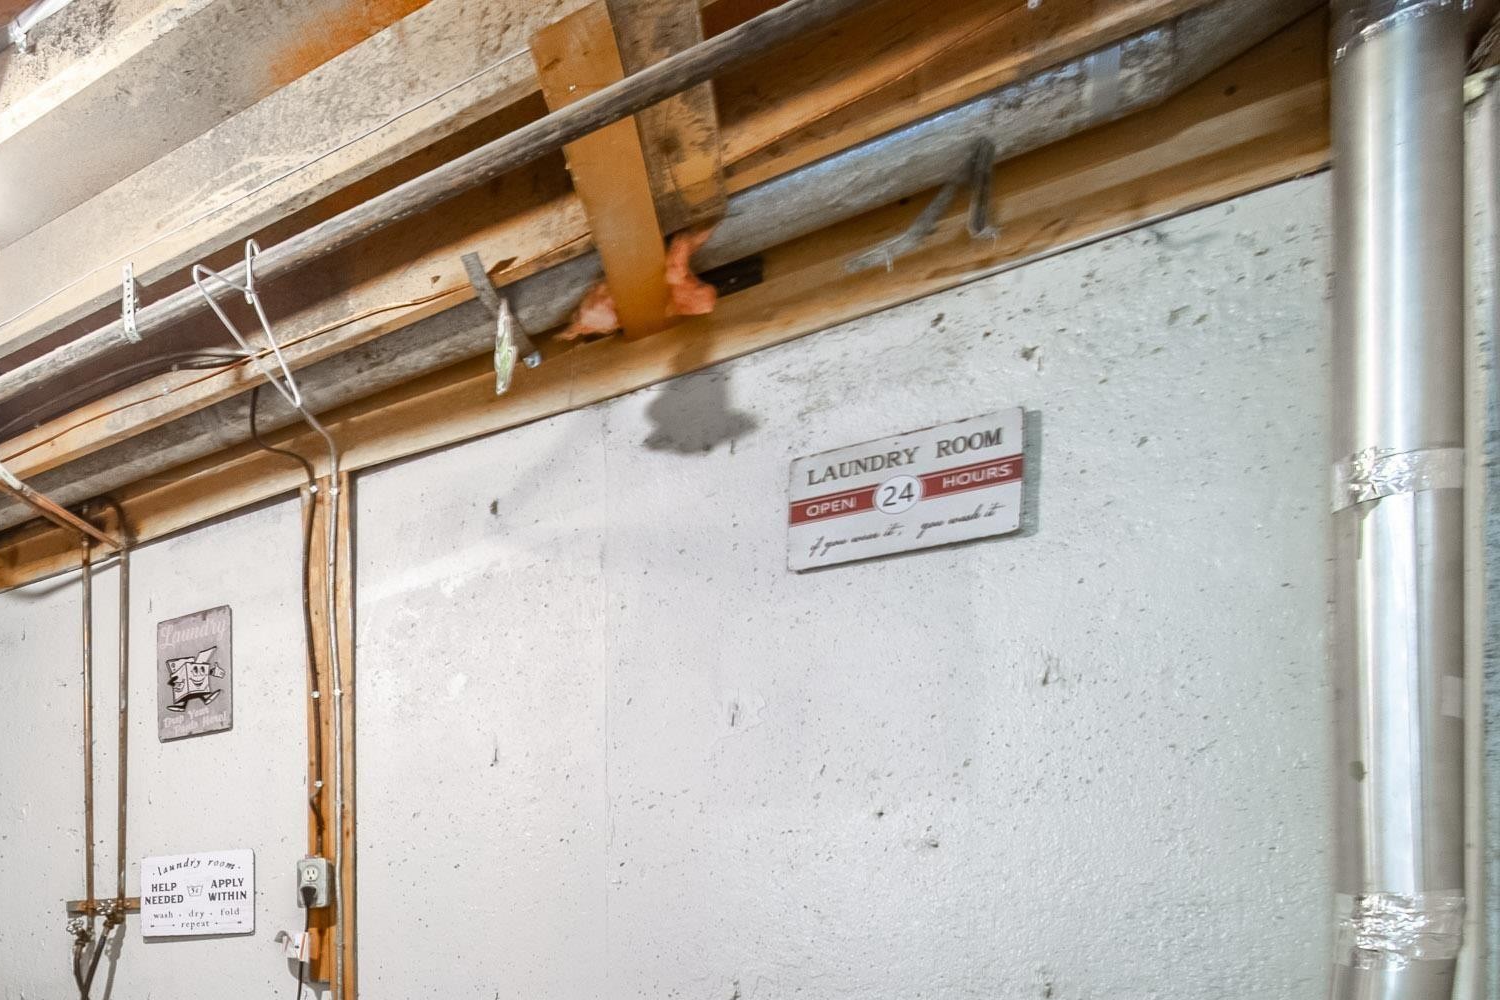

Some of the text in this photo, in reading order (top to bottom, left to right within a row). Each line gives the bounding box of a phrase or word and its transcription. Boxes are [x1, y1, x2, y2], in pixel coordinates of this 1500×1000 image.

[807, 427, 1003, 486] LAUNDRY ROOM
[805, 463, 1014, 518] OPEN 24 HOURS
[916, 519, 945, 540] you
[947, 503, 982, 526] wash
[159, 618, 228, 650] Laundry
[157, 857, 236, 877] laundry room
[151, 882, 178, 893] HELP
[210, 877, 245, 889] APPLY
[144, 890, 247, 905] NEEDED WITHIN
[153, 907, 240, 920] wash dry fold
[180, 920, 210, 931] repeat
